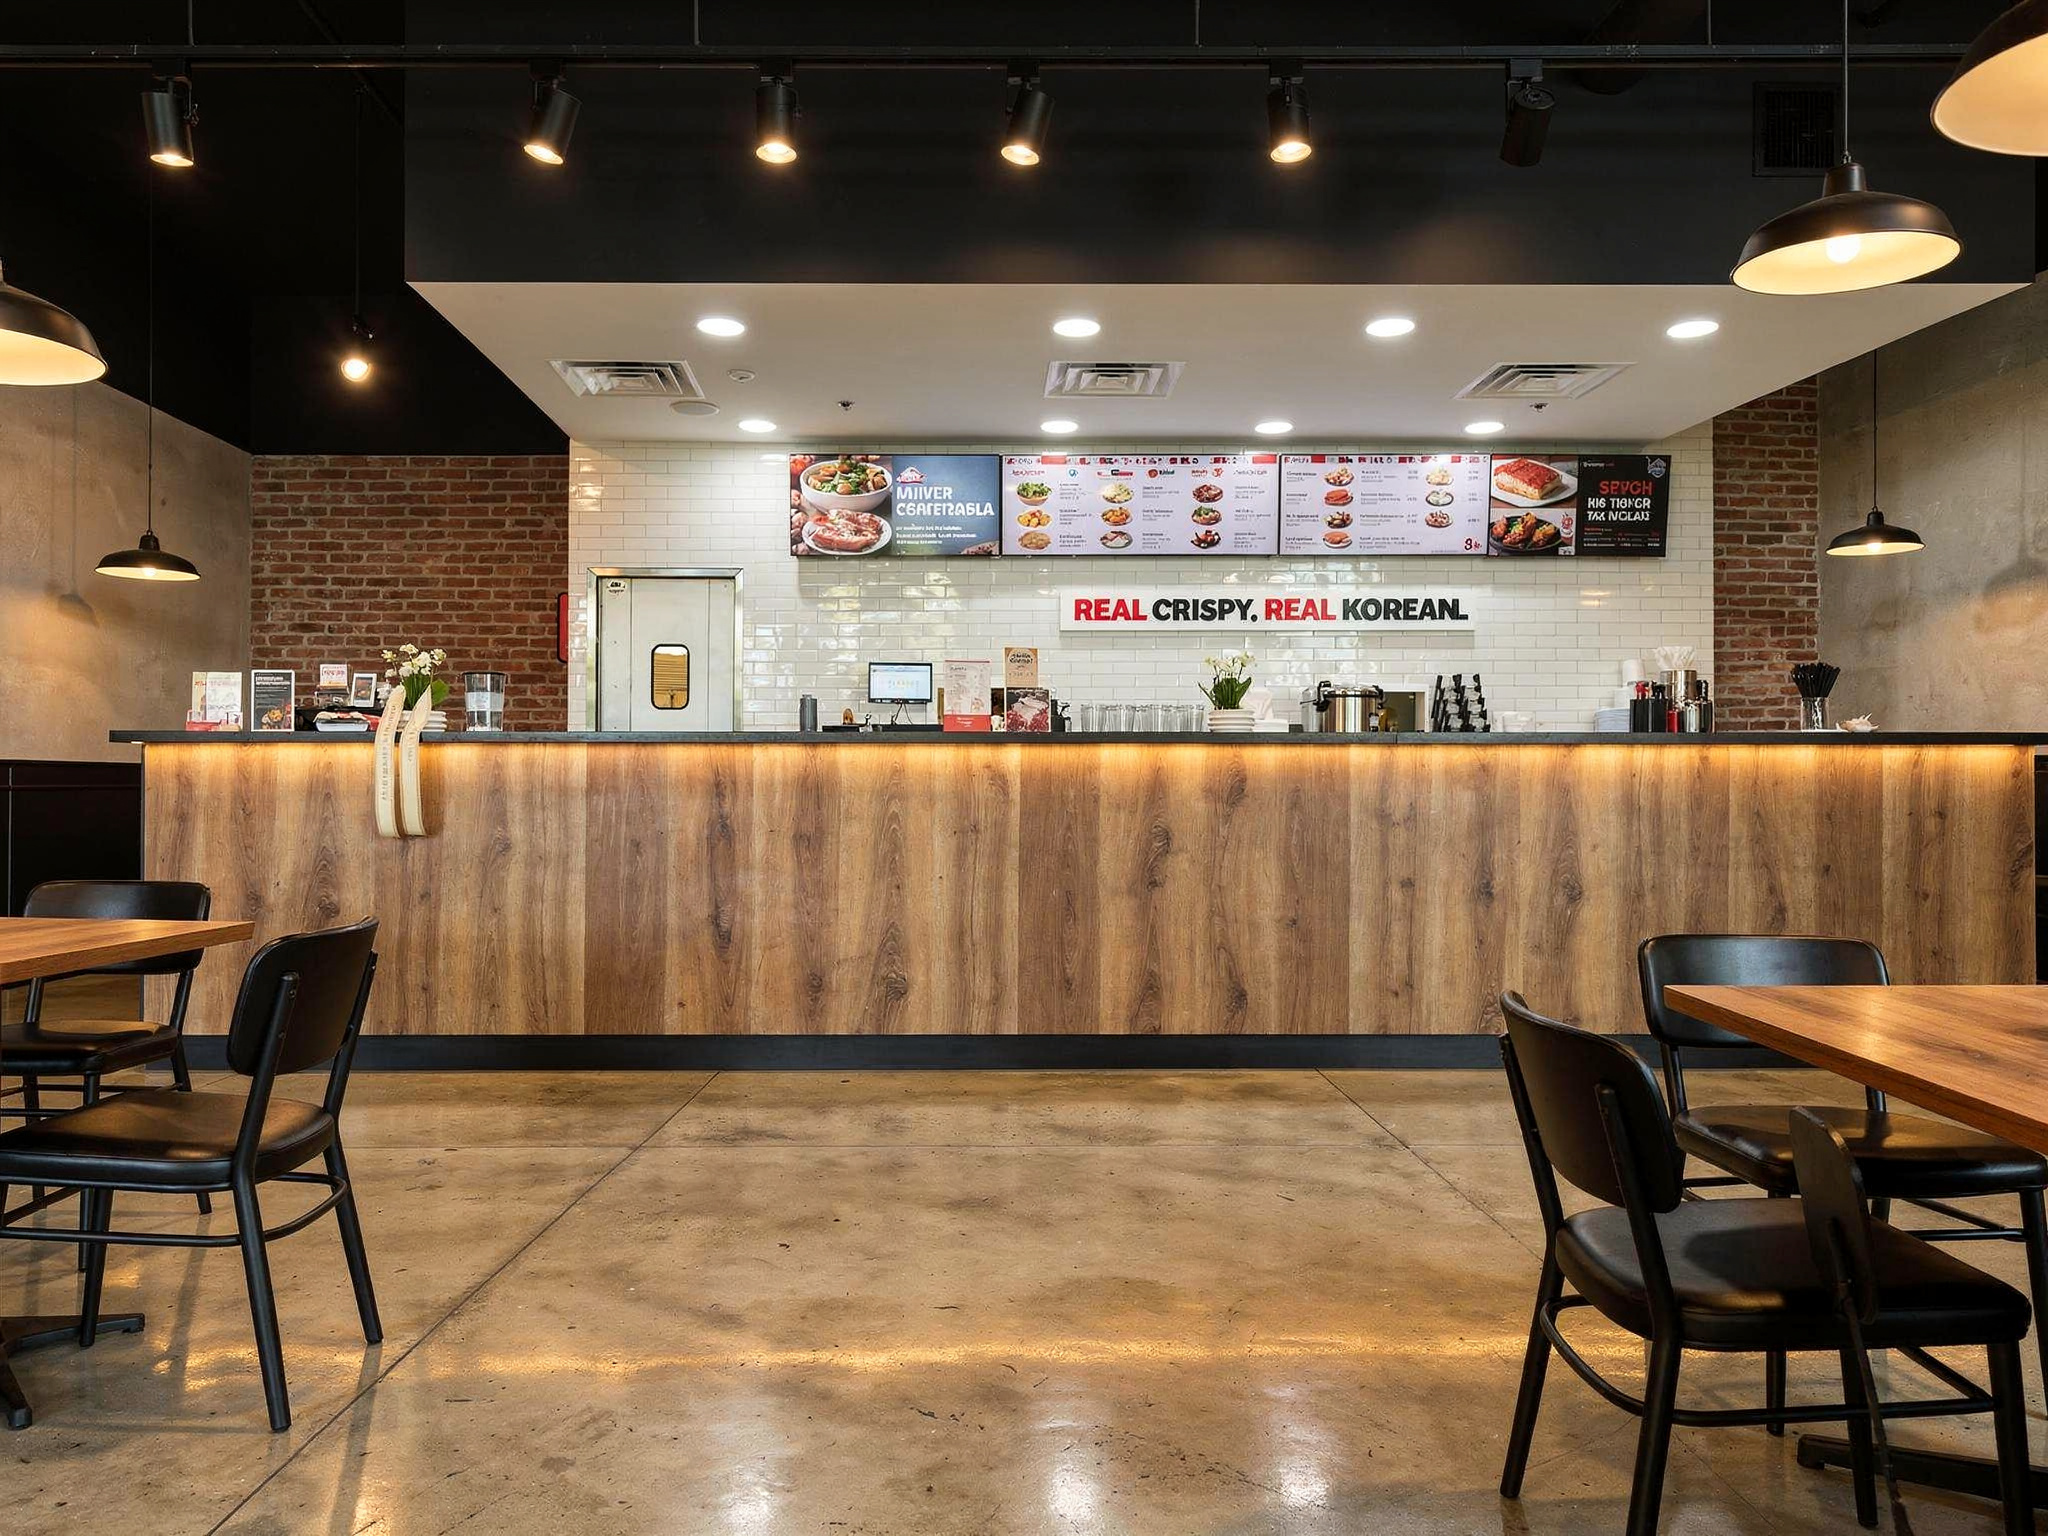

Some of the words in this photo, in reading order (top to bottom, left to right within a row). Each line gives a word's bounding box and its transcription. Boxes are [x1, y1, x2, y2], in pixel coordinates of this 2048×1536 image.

[1074, 598, 1148, 621] REAL
[1152, 598, 1258, 622] CRISPY.
[1265, 598, 1337, 621] REAL
